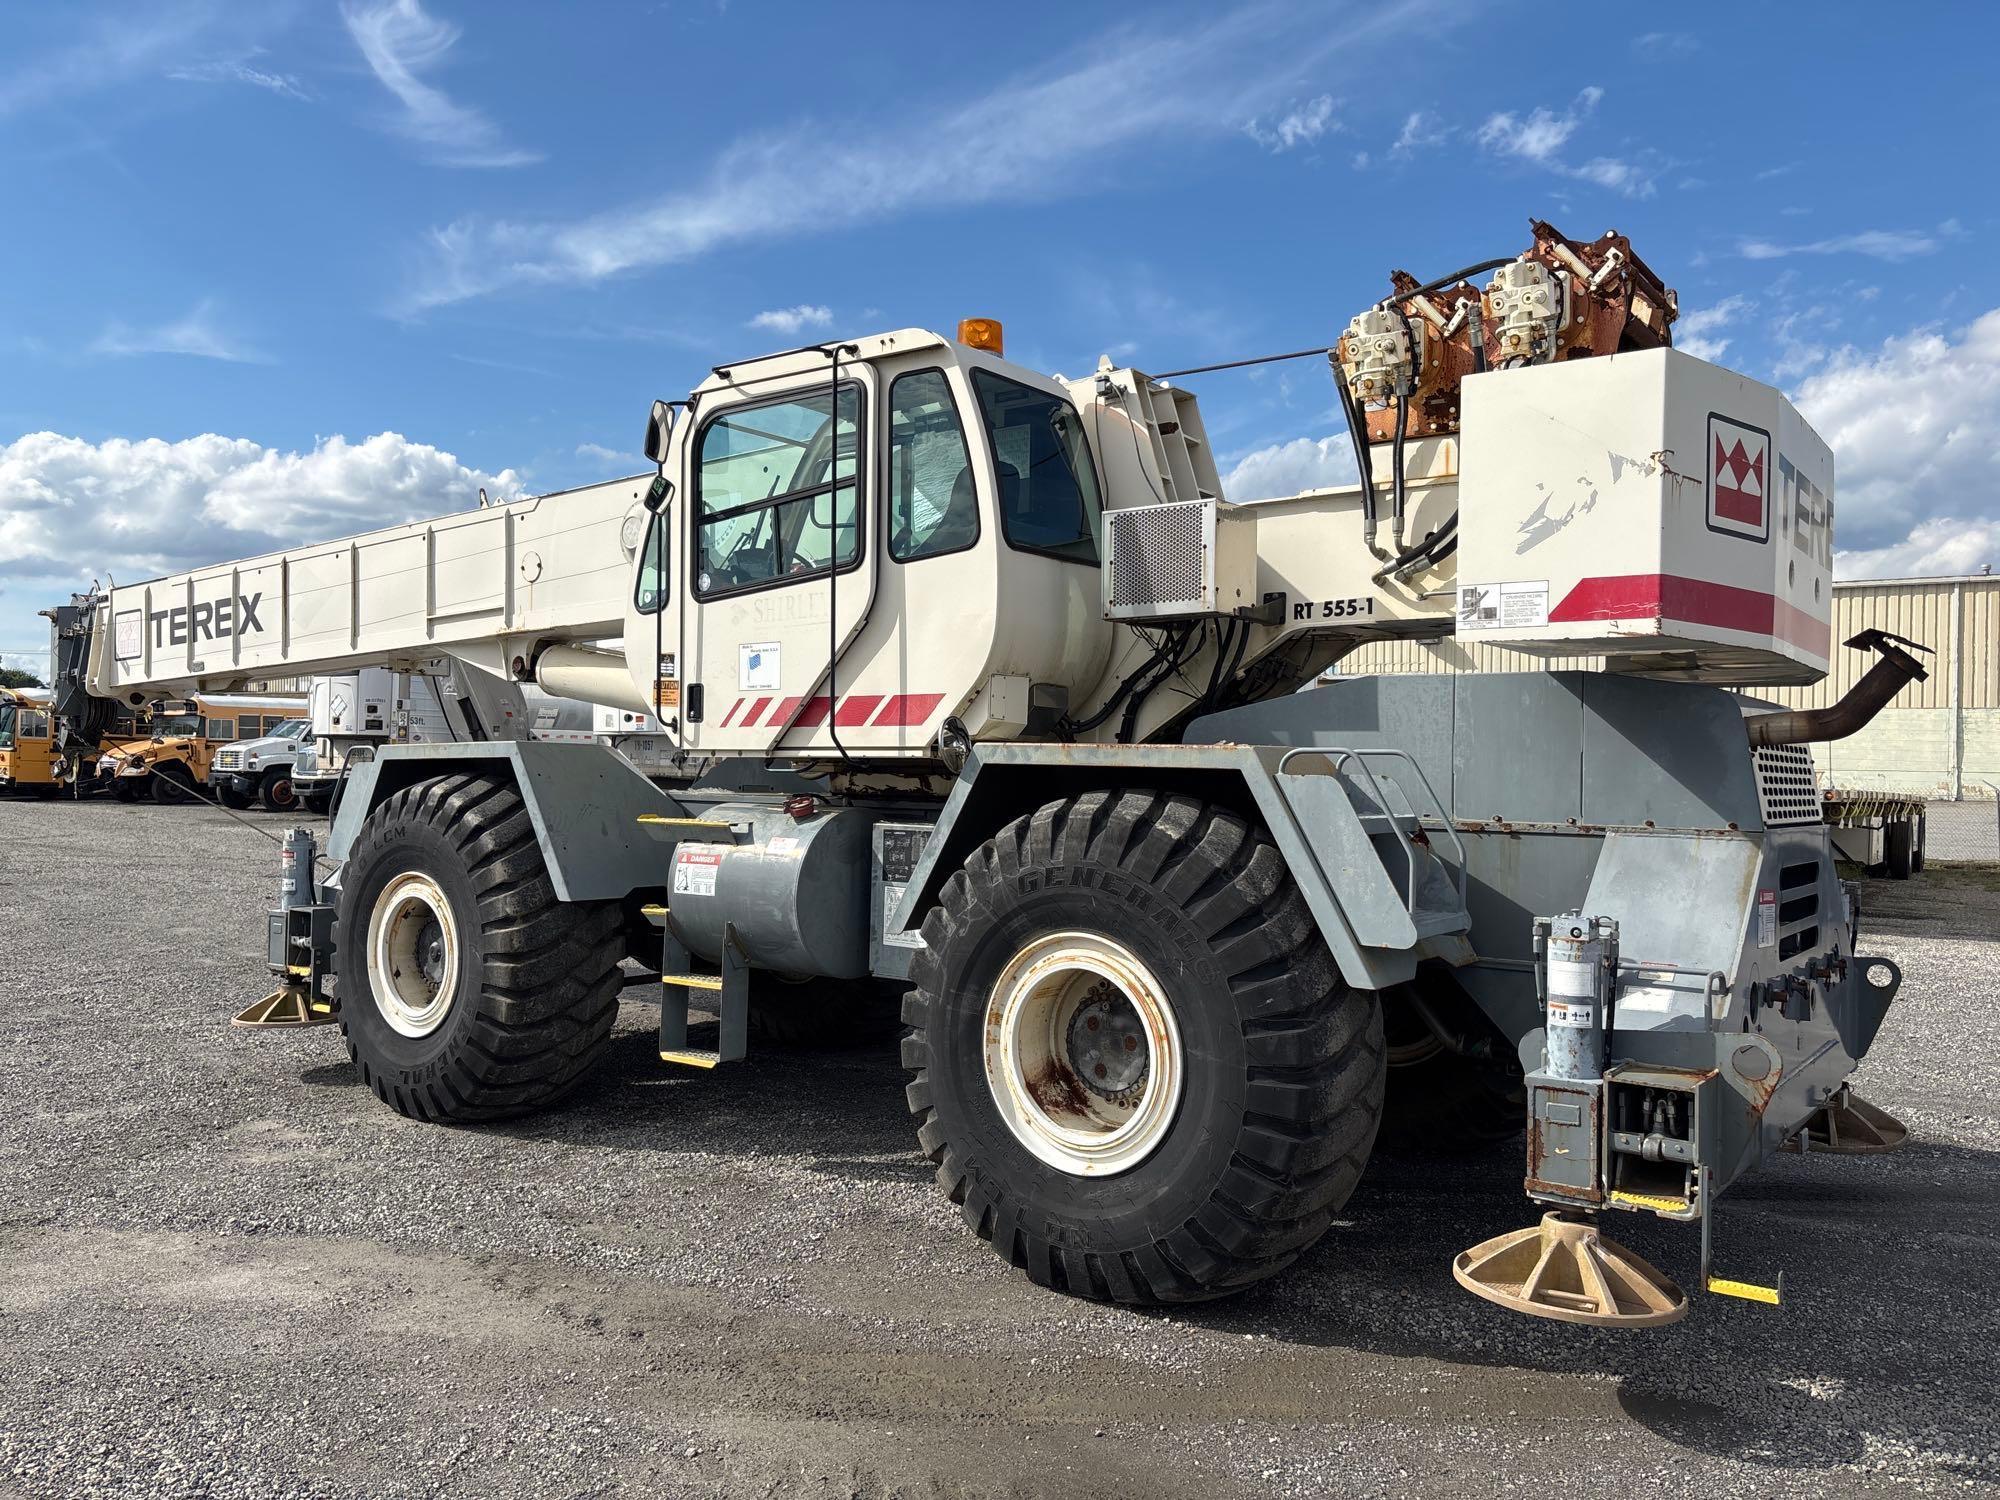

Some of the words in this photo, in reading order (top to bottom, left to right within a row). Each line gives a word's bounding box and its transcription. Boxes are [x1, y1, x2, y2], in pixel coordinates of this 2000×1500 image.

[150, 592, 264, 648] TEREX
[1293, 602, 1314, 620] RT
[1322, 597, 1373, 618] 555-1
[654, 681, 678, 689] CUTION
[373, 826, 406, 850] LCM
[690, 855, 716, 863] DANGER
[1018, 865, 1199, 960] GENERAL
